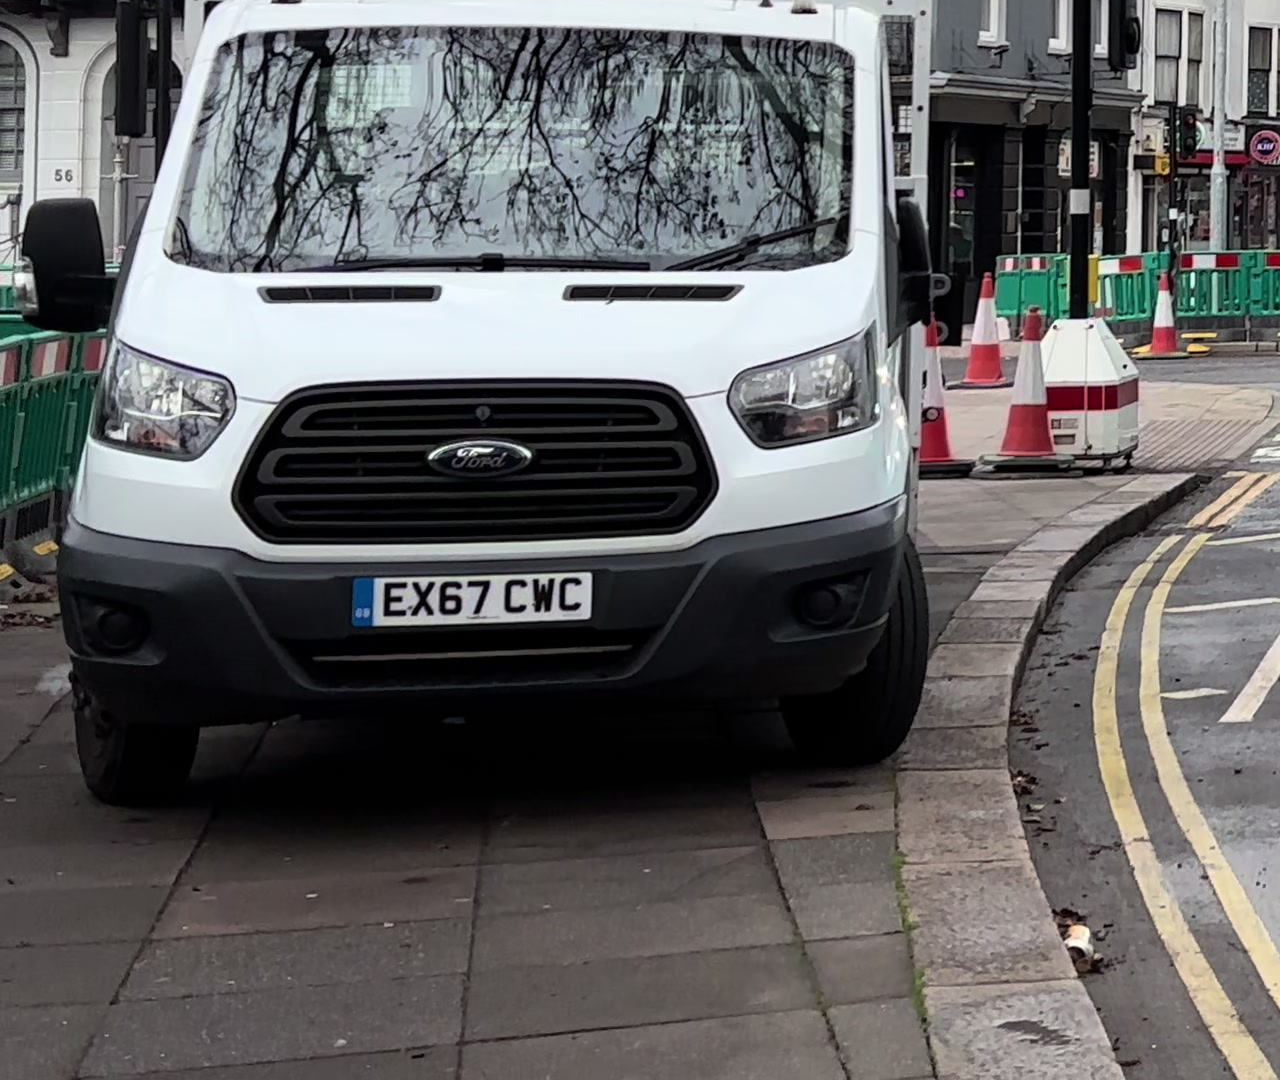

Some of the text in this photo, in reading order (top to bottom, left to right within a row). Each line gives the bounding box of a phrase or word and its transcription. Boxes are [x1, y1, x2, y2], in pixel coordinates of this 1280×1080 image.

[54, 169, 73, 182] 56
[451, 447, 507, 469] Ford
[383, 577, 583, 617] EX67 CWC
